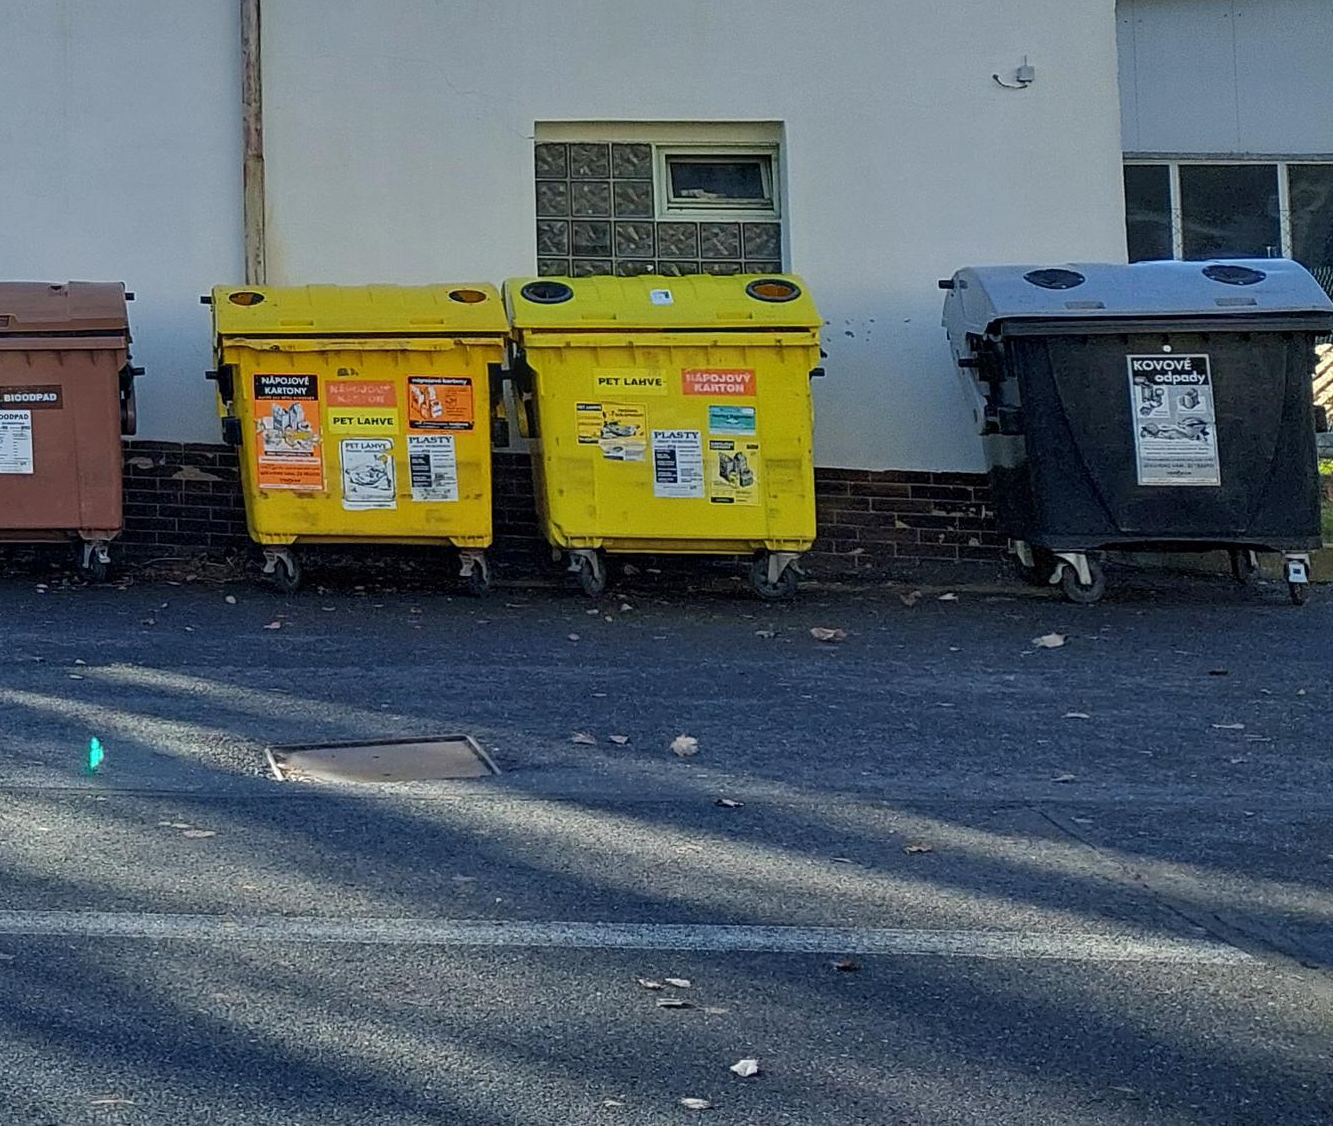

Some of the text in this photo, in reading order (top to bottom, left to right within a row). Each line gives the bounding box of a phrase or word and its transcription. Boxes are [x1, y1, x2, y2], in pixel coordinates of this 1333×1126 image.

[1133, 356, 1192, 371] KOVOVÉ
[261, 376, 310, 385] NÁPOJOVÉ
[598, 377, 662, 387] PET LAHVE
[686, 372, 751, 383] NÁPOJOVÝ
[1154, 371, 1206, 385] odpady
[264, 387, 307, 395] KARTONY
[693, 383, 744, 393] KARTON
[3, 393, 57, 403] BIOODPAD
[338, 395, 385, 404] KON
[333, 417, 394, 426] PET LAHVE
[654, 431, 699, 439] PLASTY
[409, 436, 452, 444] PLASTY
[345, 442, 359, 450] PET
